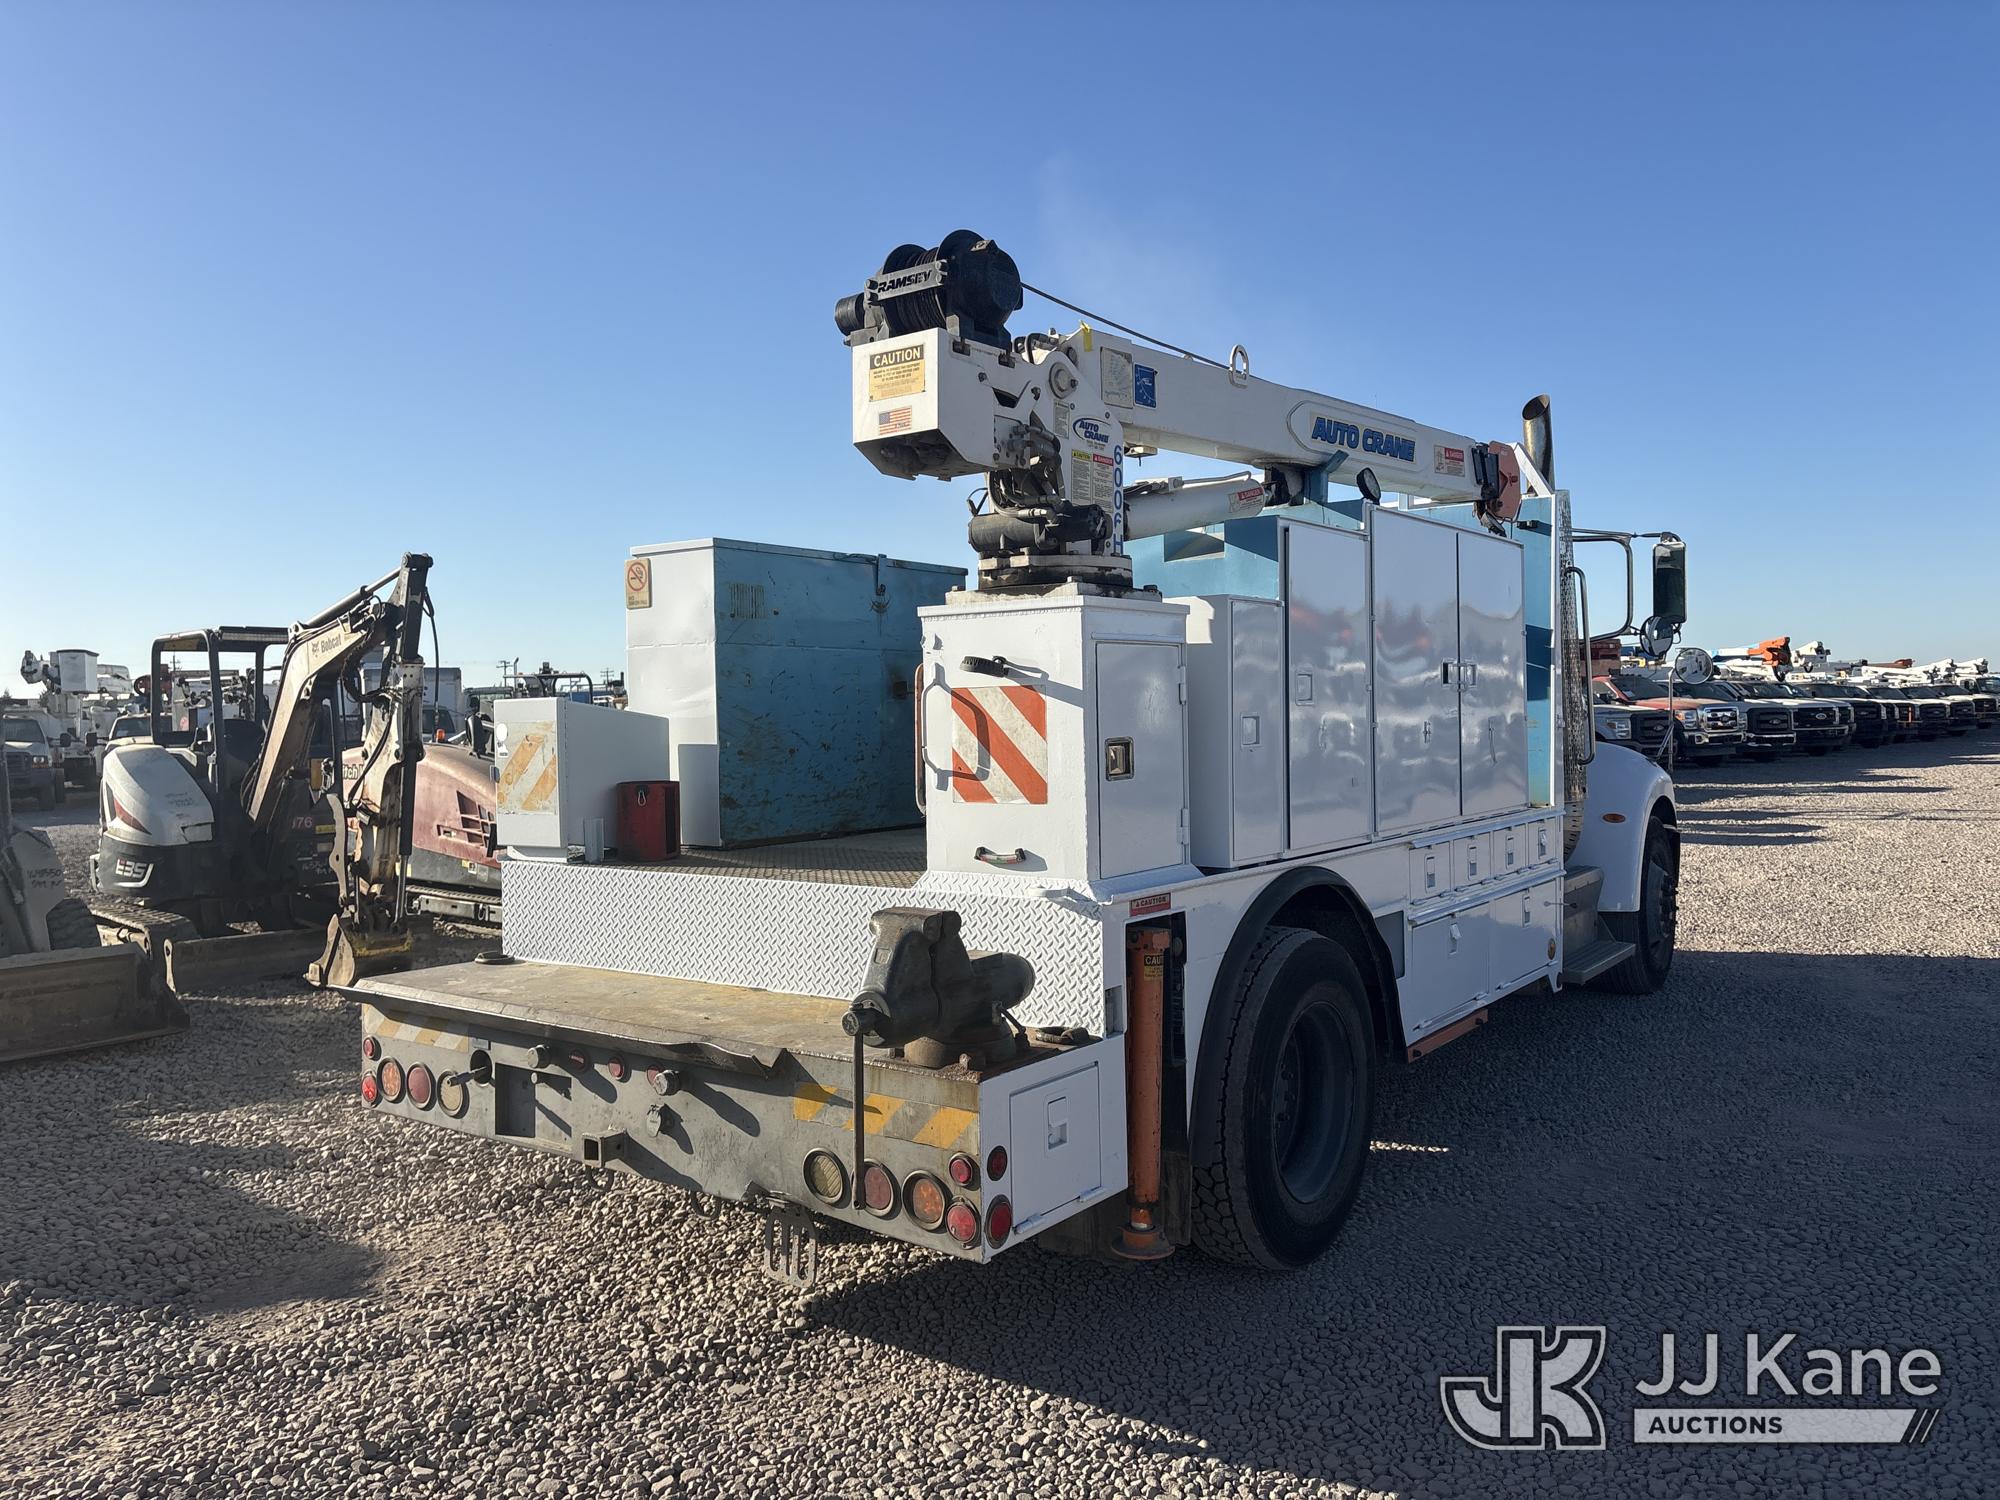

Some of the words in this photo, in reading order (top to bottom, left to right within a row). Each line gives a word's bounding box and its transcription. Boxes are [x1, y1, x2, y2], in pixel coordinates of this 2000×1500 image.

[878, 269, 932, 293] RAMSEY
[873, 346, 921, 367] CAUTION
[1079, 421, 1099, 432] AUTO
[1084, 431, 1109, 443] CRANE
[1312, 417, 1359, 449] AUTO
[1363, 428, 1415, 462] CRANE
[320, 633, 342, 653] Bobcat
[342, 764, 359, 779] itch
[115, 858, 148, 878] E35
[1140, 896, 1166, 906] CAUTION
